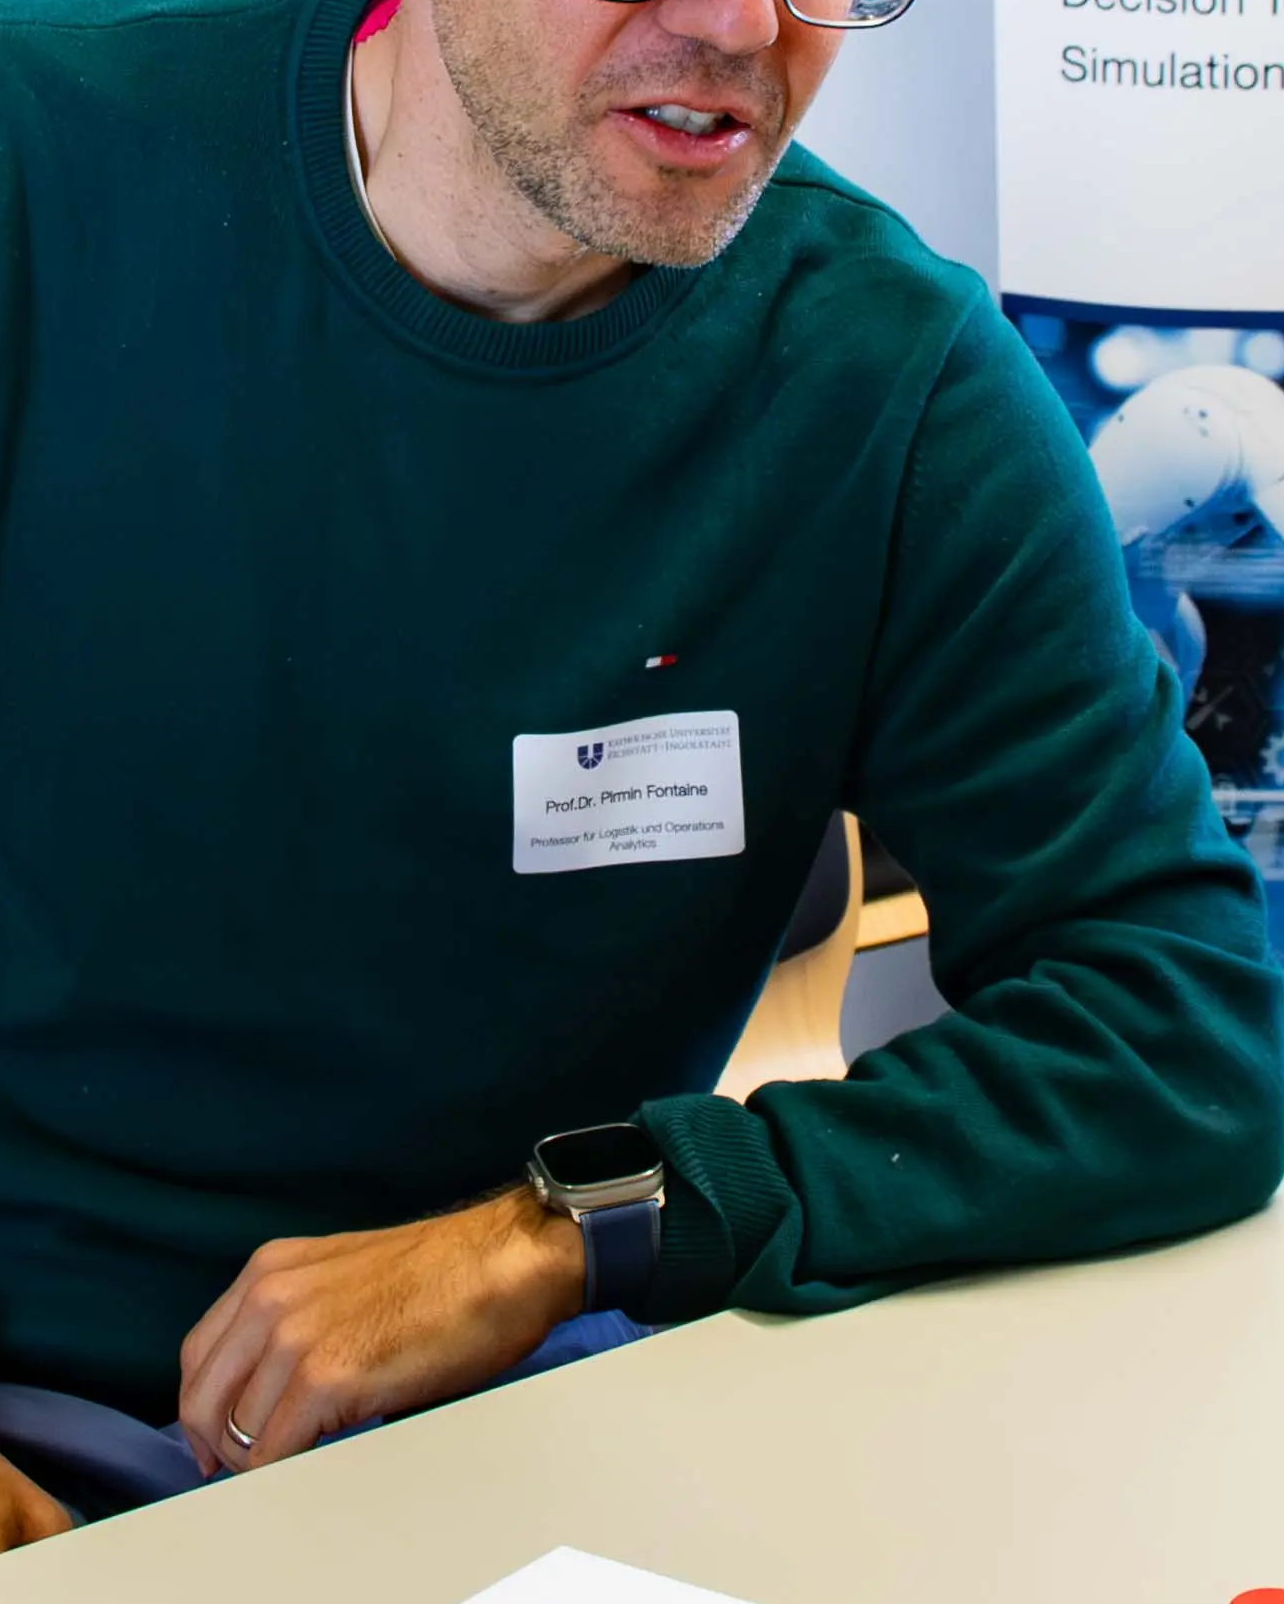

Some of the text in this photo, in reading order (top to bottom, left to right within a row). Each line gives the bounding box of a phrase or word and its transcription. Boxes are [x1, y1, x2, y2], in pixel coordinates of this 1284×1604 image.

[600, 785, 643, 806] Pirmin
[646, 782, 709, 800] Fontaine
[530, 819, 725, 848] Professor Logistik und Operations
[608, 837, 658, 853] Analytics
